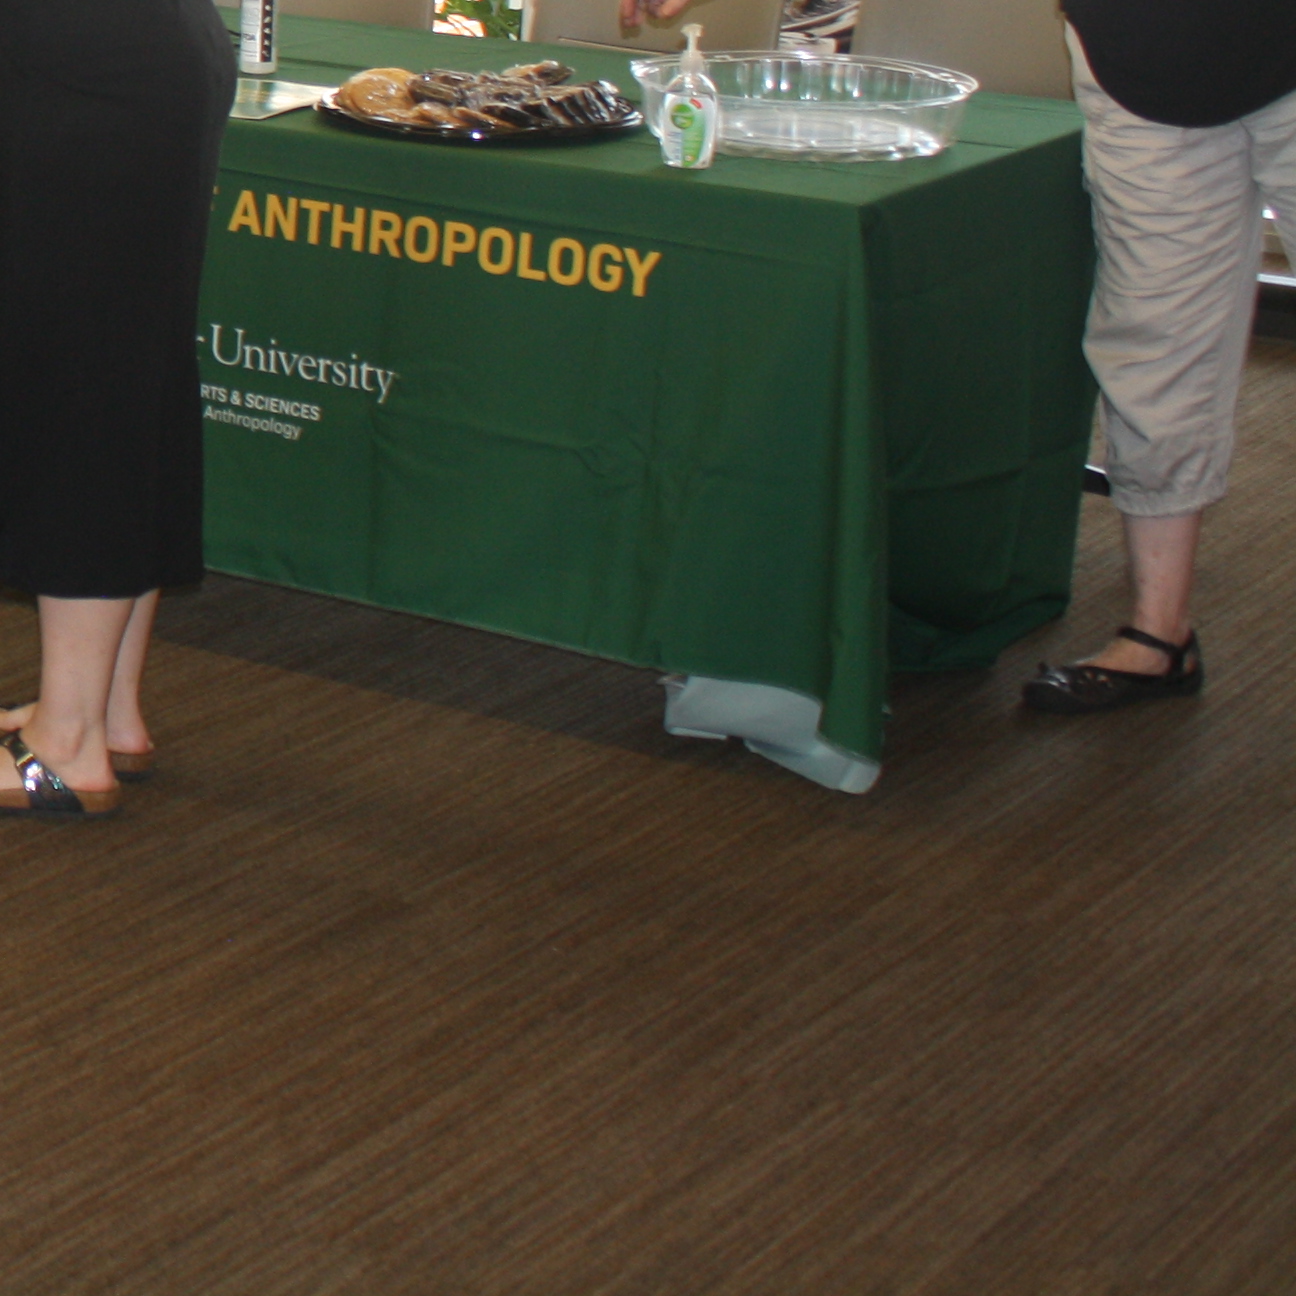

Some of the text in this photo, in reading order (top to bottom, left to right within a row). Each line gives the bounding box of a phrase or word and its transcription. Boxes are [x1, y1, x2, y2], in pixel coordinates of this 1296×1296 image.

[227, 189, 662, 298] ANTHROPOLOGY
[210, 323, 397, 404] University
[203, 405, 303, 441] Anthropology
[230, 390, 243, 406] &
[244, 392, 322, 421] SCIENCES
